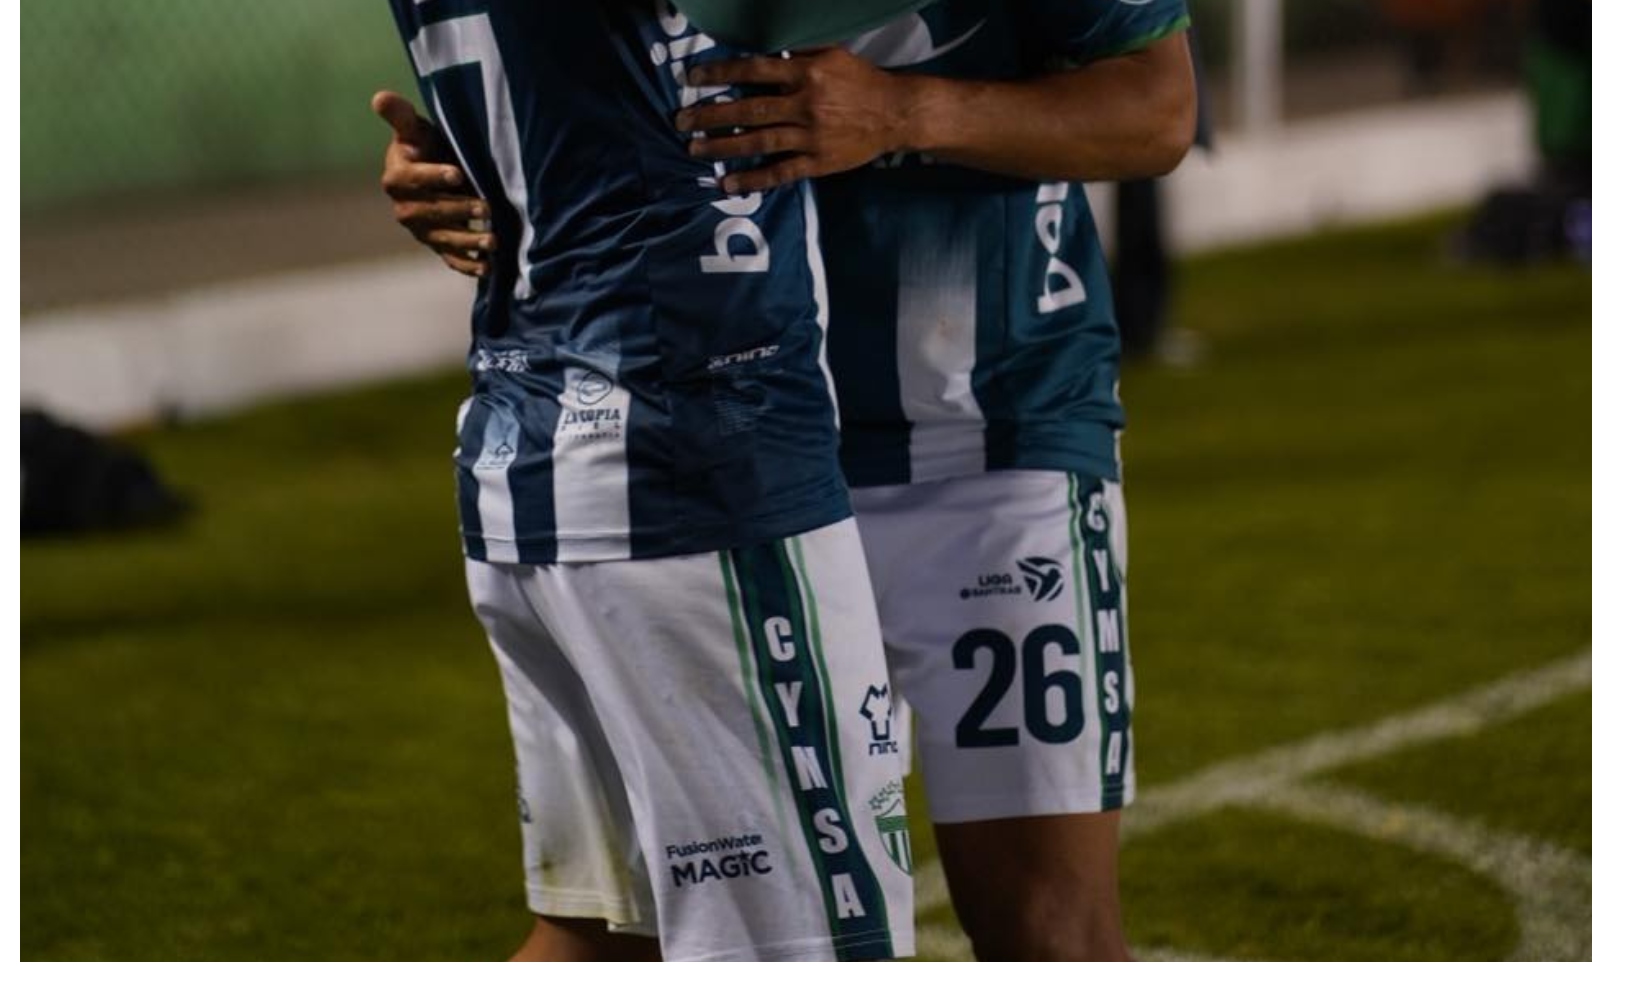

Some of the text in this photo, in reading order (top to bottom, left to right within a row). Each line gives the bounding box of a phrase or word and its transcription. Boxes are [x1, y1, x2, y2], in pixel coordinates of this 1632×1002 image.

[952, 623, 1085, 749] 26
[1086, 492, 1123, 774] CYMSA
[671, 849, 772, 887] MAGIC
[764, 616, 866, 920] CYMSA
